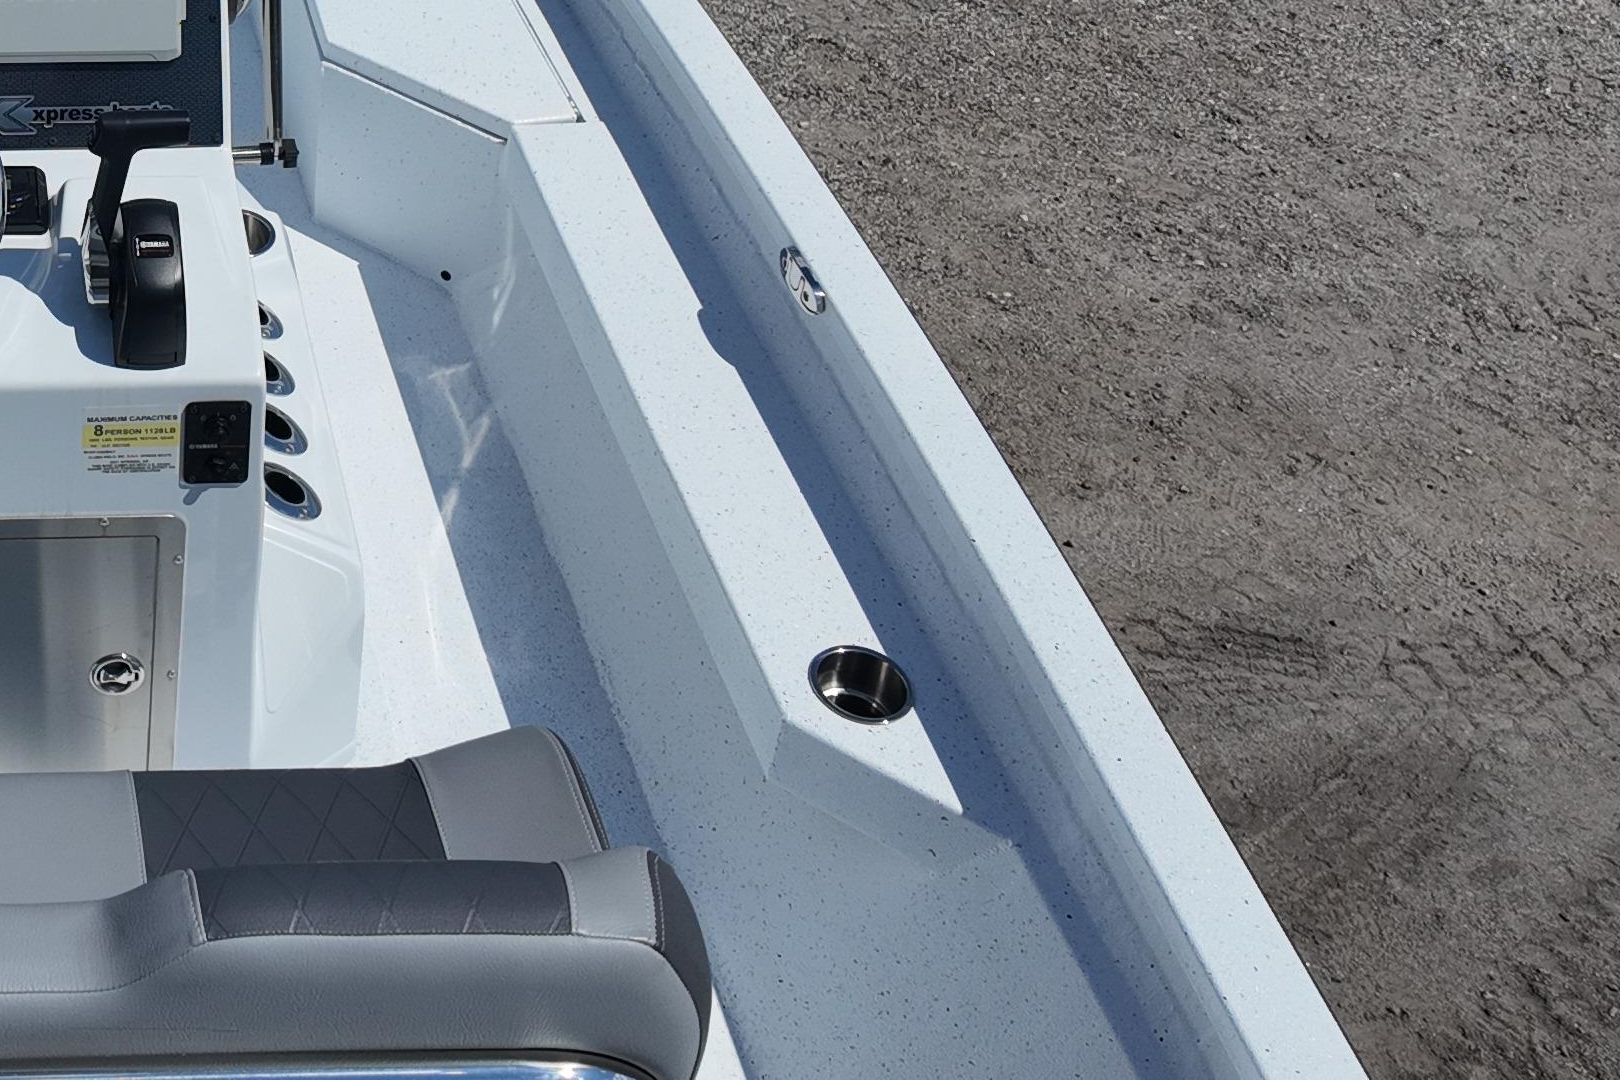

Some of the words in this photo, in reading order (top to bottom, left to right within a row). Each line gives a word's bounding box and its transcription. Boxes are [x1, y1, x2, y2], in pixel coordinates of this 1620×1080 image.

[32, 106, 105, 127] xpress
[86, 415, 128, 423] MAXIMUM
[128, 414, 178, 422] CAPACITIES
[93, 424, 104, 437] 8
[104, 428, 142, 436] PERSON
